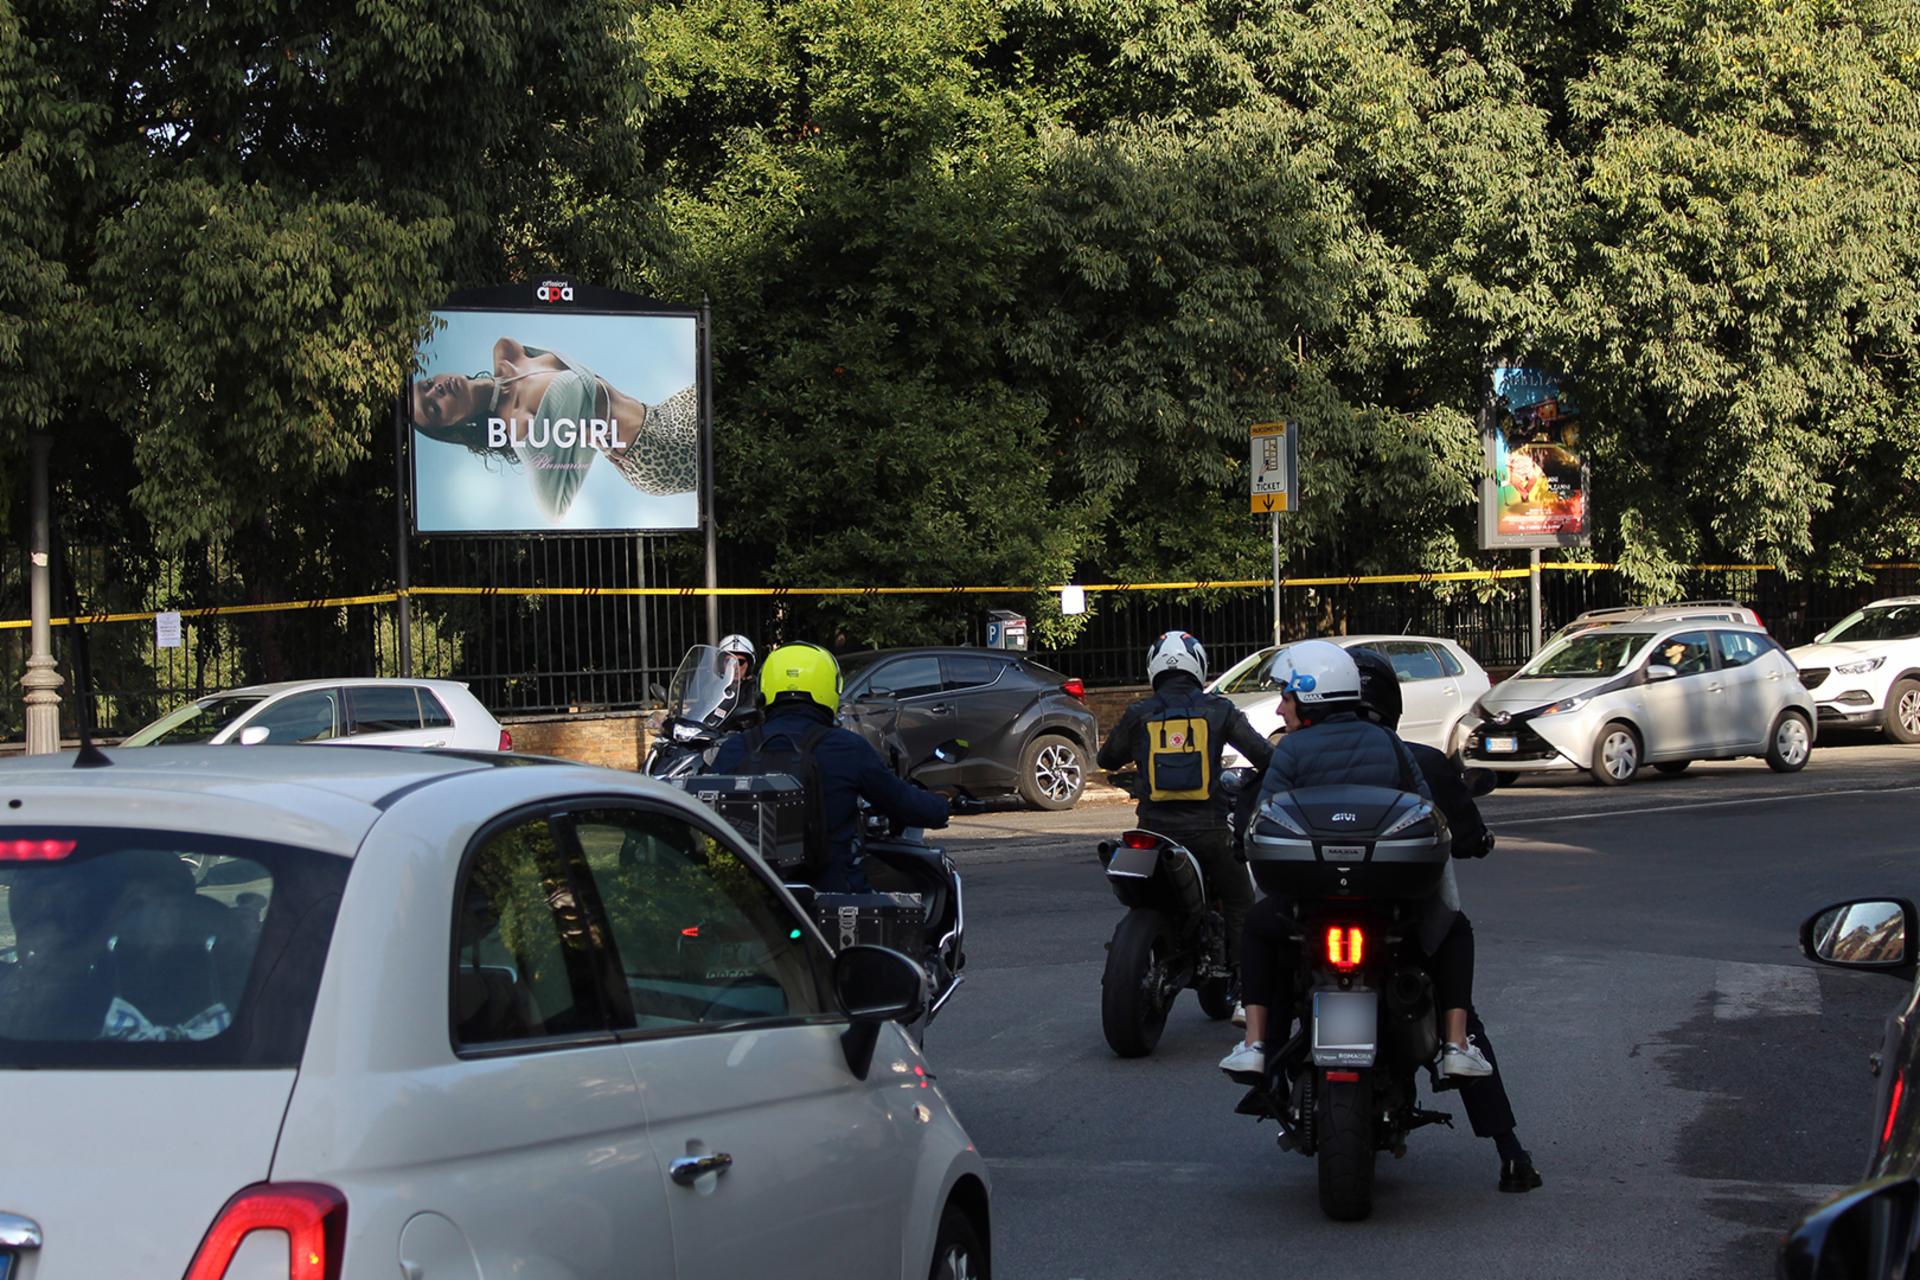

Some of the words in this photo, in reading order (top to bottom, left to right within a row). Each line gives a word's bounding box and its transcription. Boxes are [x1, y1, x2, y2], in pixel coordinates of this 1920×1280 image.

[537, 287, 574, 304] apa
[487, 418, 627, 449] BLUGIRL
[1256, 482, 1281, 491] TICKET
[1331, 812, 1356, 822] GIVI
